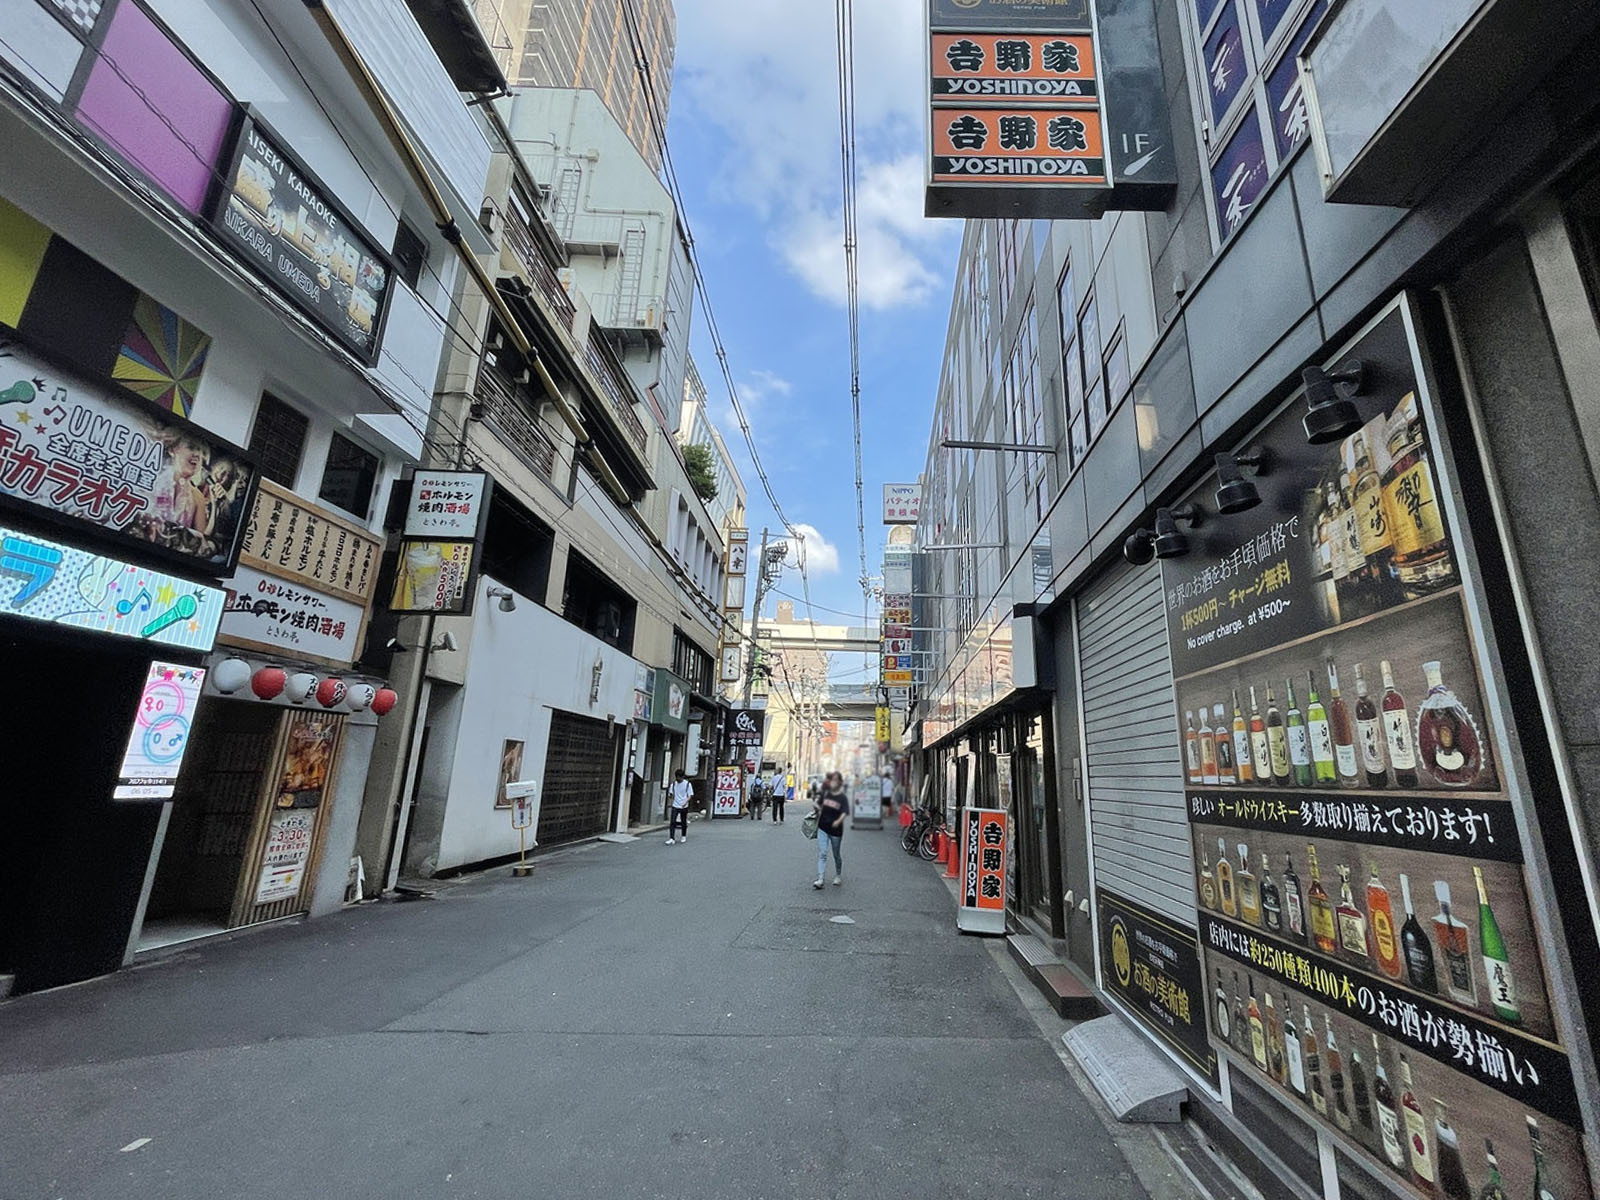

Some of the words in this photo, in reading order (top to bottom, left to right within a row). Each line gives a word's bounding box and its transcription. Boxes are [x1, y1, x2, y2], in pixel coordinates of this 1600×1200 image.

[945, 38, 1081, 74] 吉野家
[948, 79, 1082, 96] YOSHINOYA
[946, 114, 1089, 152] 吉野家
[949, 157, 1089, 175] YOSHINOYA
[287, 172, 338, 230] KARAOKE
[277, 254, 321, 304] UMEDA
[47, 432, 157, 492] 全席完全個室
[68, 405, 164, 472] UMEDA
[417, 503, 471, 515] 焼肉酒場
[892, 487, 914, 495] NIPPO
[1168, 515, 1299, 611] 世界のお酒をお手頃価格で
[1229, 559, 1291, 608] チャージ無料
[236, 593, 346, 641] ホモン焼肉酒場
[1187, 638, 1197, 650] No
[1197, 629, 1216, 646] cover
[1217, 619, 1245, 638] charge.
[1247, 611, 1258, 626] at
[967, 820, 979, 897] YOSHINOYA
[981, 821, 1004, 899] 吉野家
